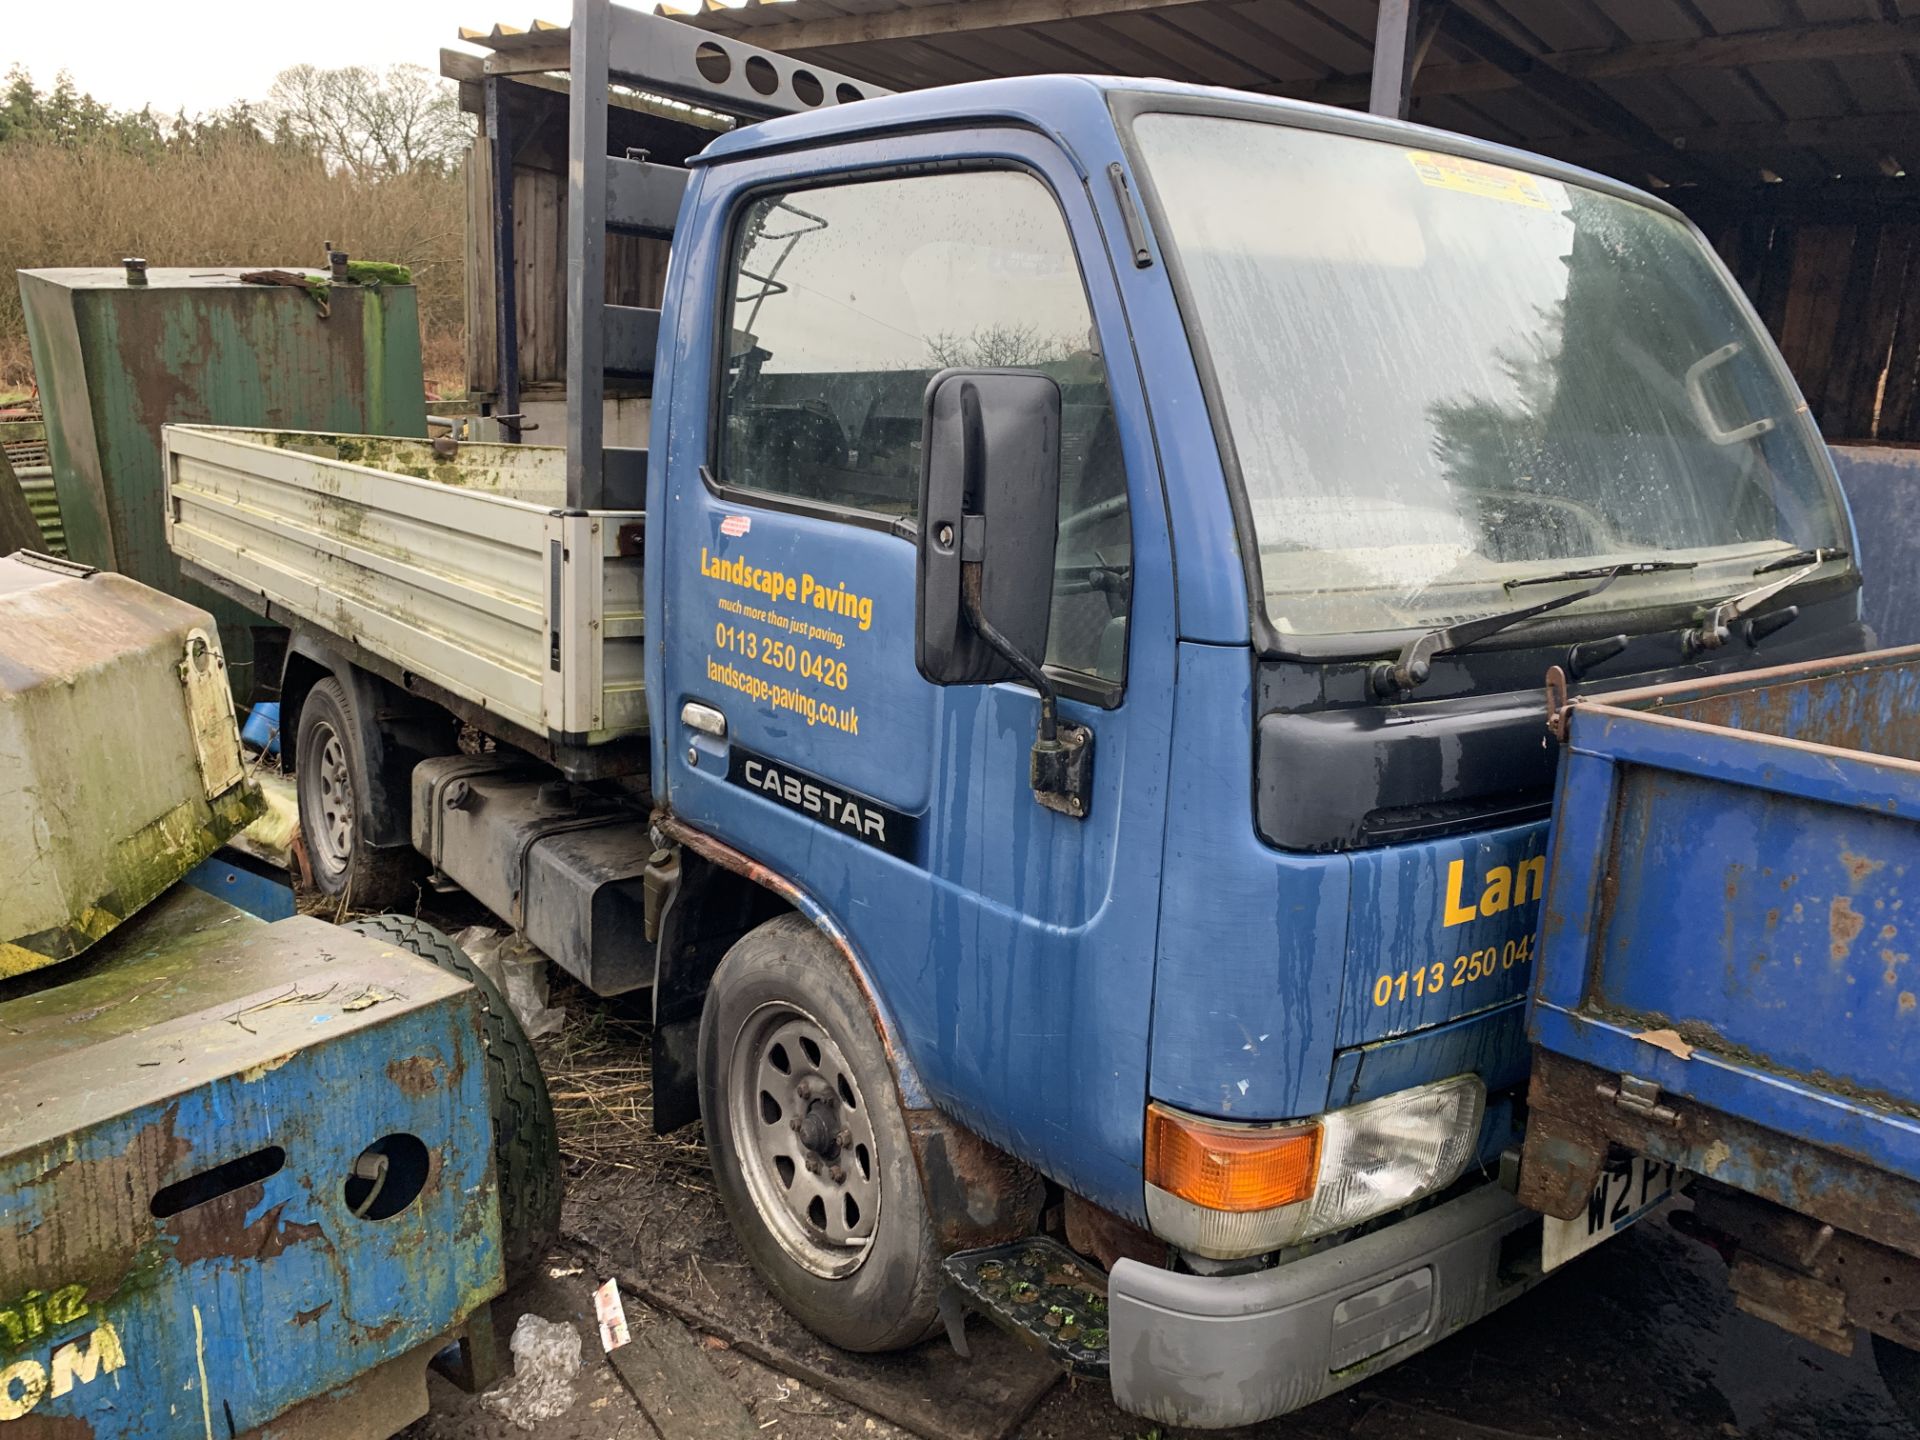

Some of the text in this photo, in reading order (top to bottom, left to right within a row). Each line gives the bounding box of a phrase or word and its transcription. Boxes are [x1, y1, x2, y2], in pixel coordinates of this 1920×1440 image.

[701, 547, 873, 631] Landscape Paving
[718, 598, 846, 649] much more than just paving.
[715, 622, 848, 690] 0113 250 0426
[707, 654, 859, 736] landscape-paving.co.uk
[745, 760, 886, 842] CABSTAR
[1443, 855, 1546, 928] Lan
[1373, 962, 1444, 1007] 0113
[1451, 946, 1497, 987] 250
